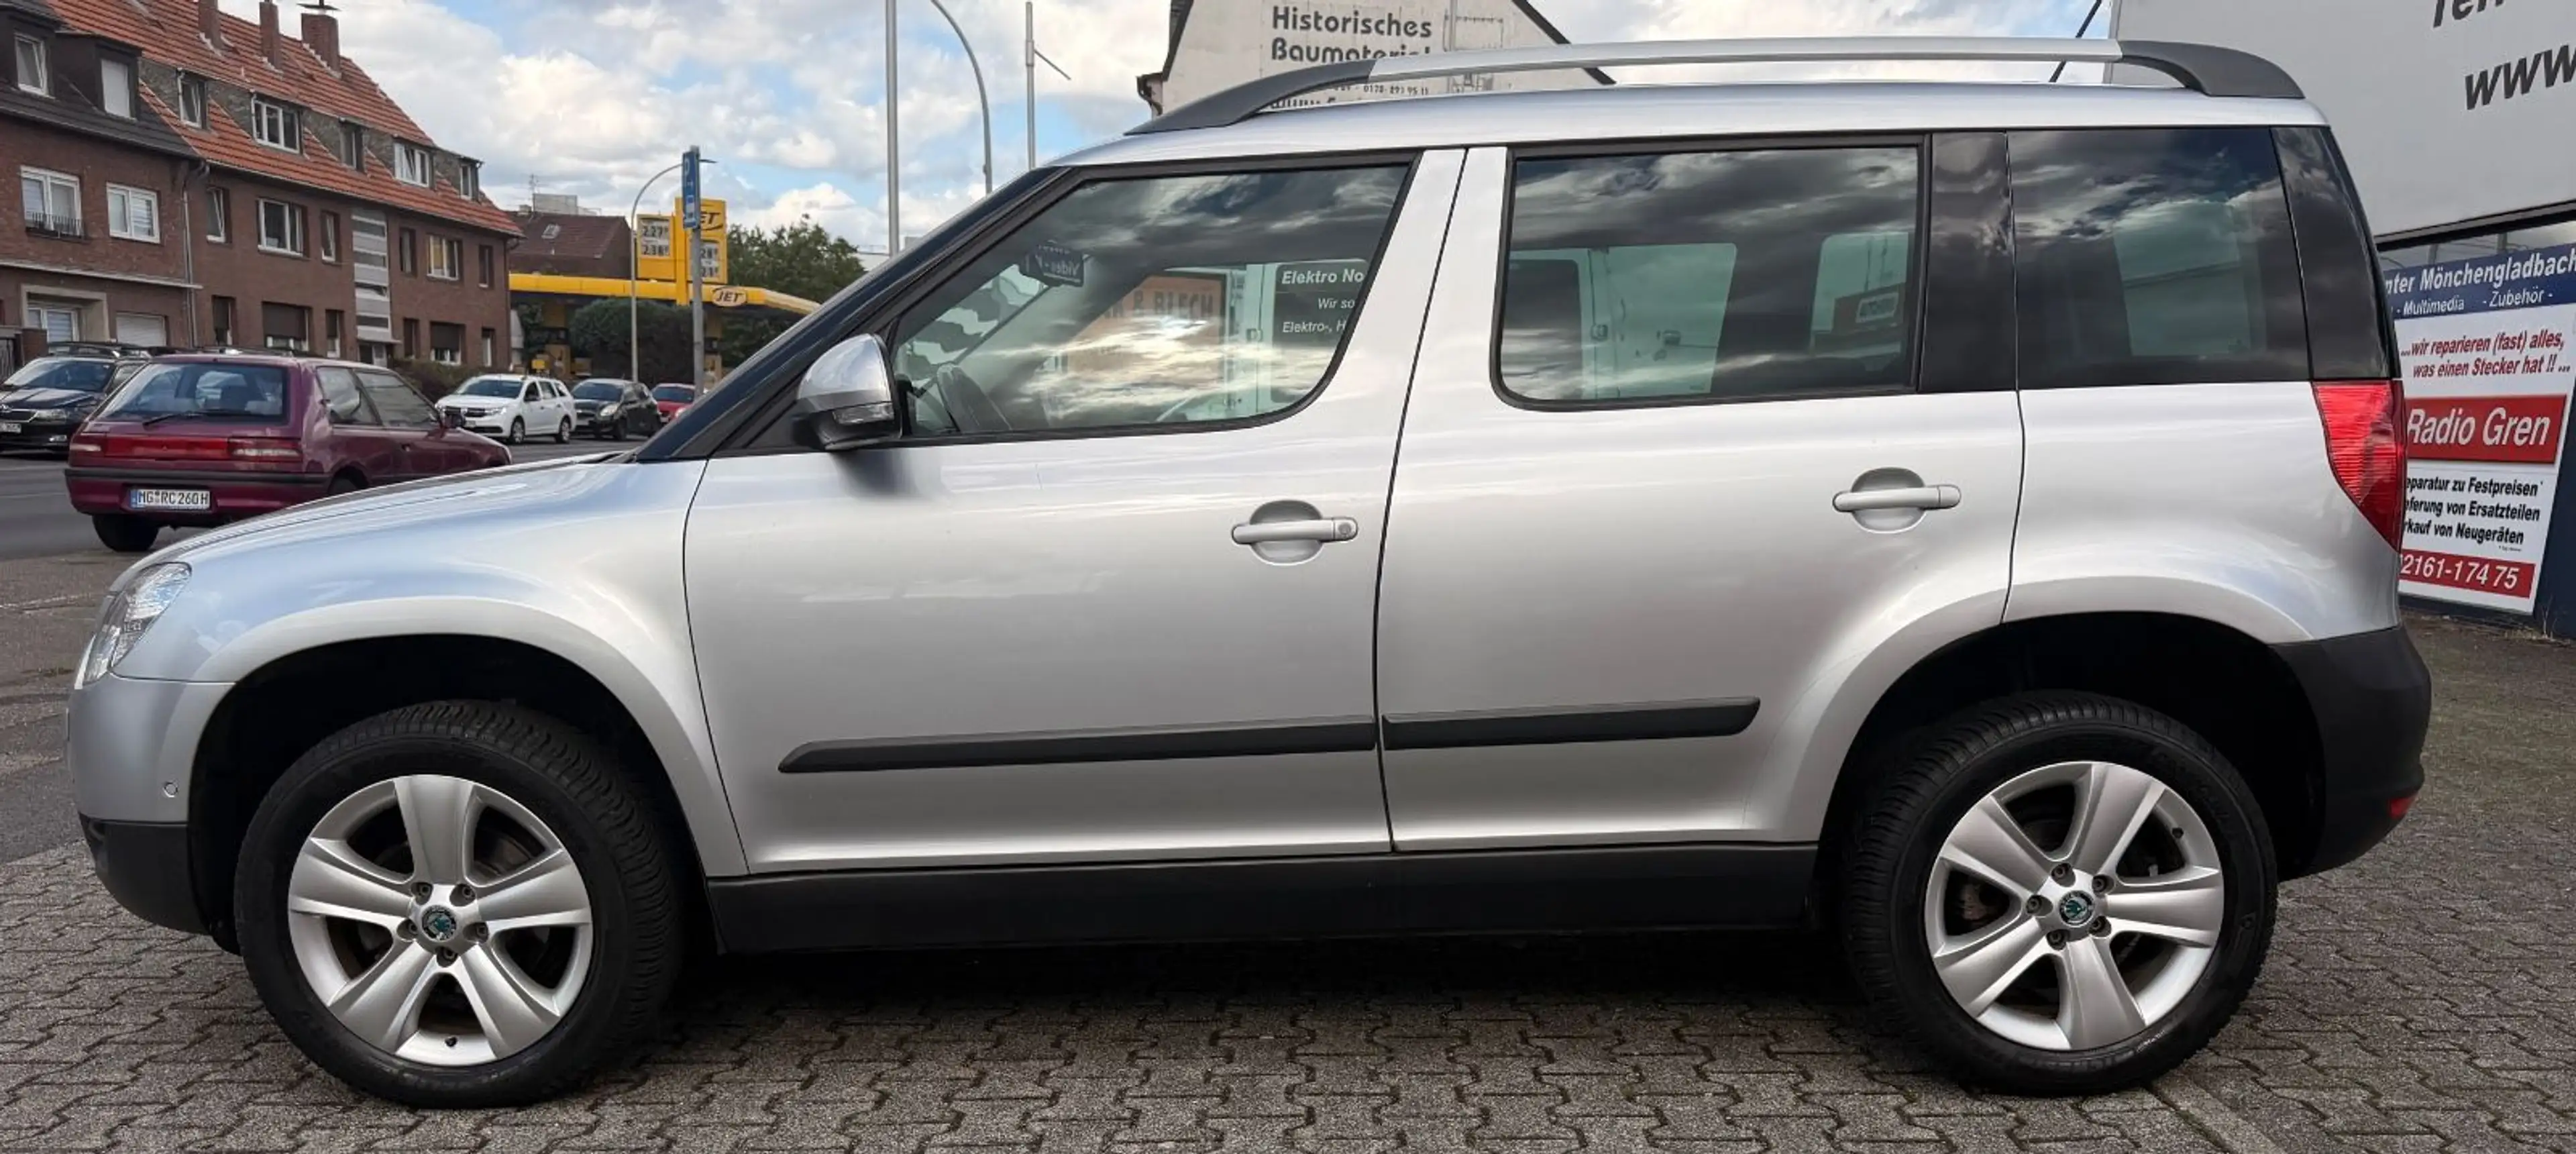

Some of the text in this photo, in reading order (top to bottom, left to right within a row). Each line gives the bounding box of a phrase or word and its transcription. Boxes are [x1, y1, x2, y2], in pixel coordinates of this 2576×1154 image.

[1273, 6, 1432, 38] Historisches
[1272, 38, 1430, 63] Baumat
[1282, 269, 1364, 284] Elektro No
[716, 291, 743, 302] JET
[1318, 298, 1337, 309] Wir
[2404, 295, 2465, 316] Multimedia
[2489, 285, 2545, 307] Zubehör
[2430, 335, 2491, 358] reparieren
[2493, 329, 2528, 356] (fast)
[2529, 328, 2565, 352] alles,
[2413, 364, 2436, 378] was
[2437, 359, 2469, 377] einen
[2472, 356, 2520, 376] Stecker
[2521, 355, 2544, 374] hat
[2406, 407, 2551, 446] Radio Gren
[2452, 480, 2466, 492] zu
[2447, 503, 2466, 515] von
[2468, 501, 2540, 521] Ersatzteilen
[2434, 525, 2453, 537] von
[2455, 523, 2524, 545] Neugeräten
